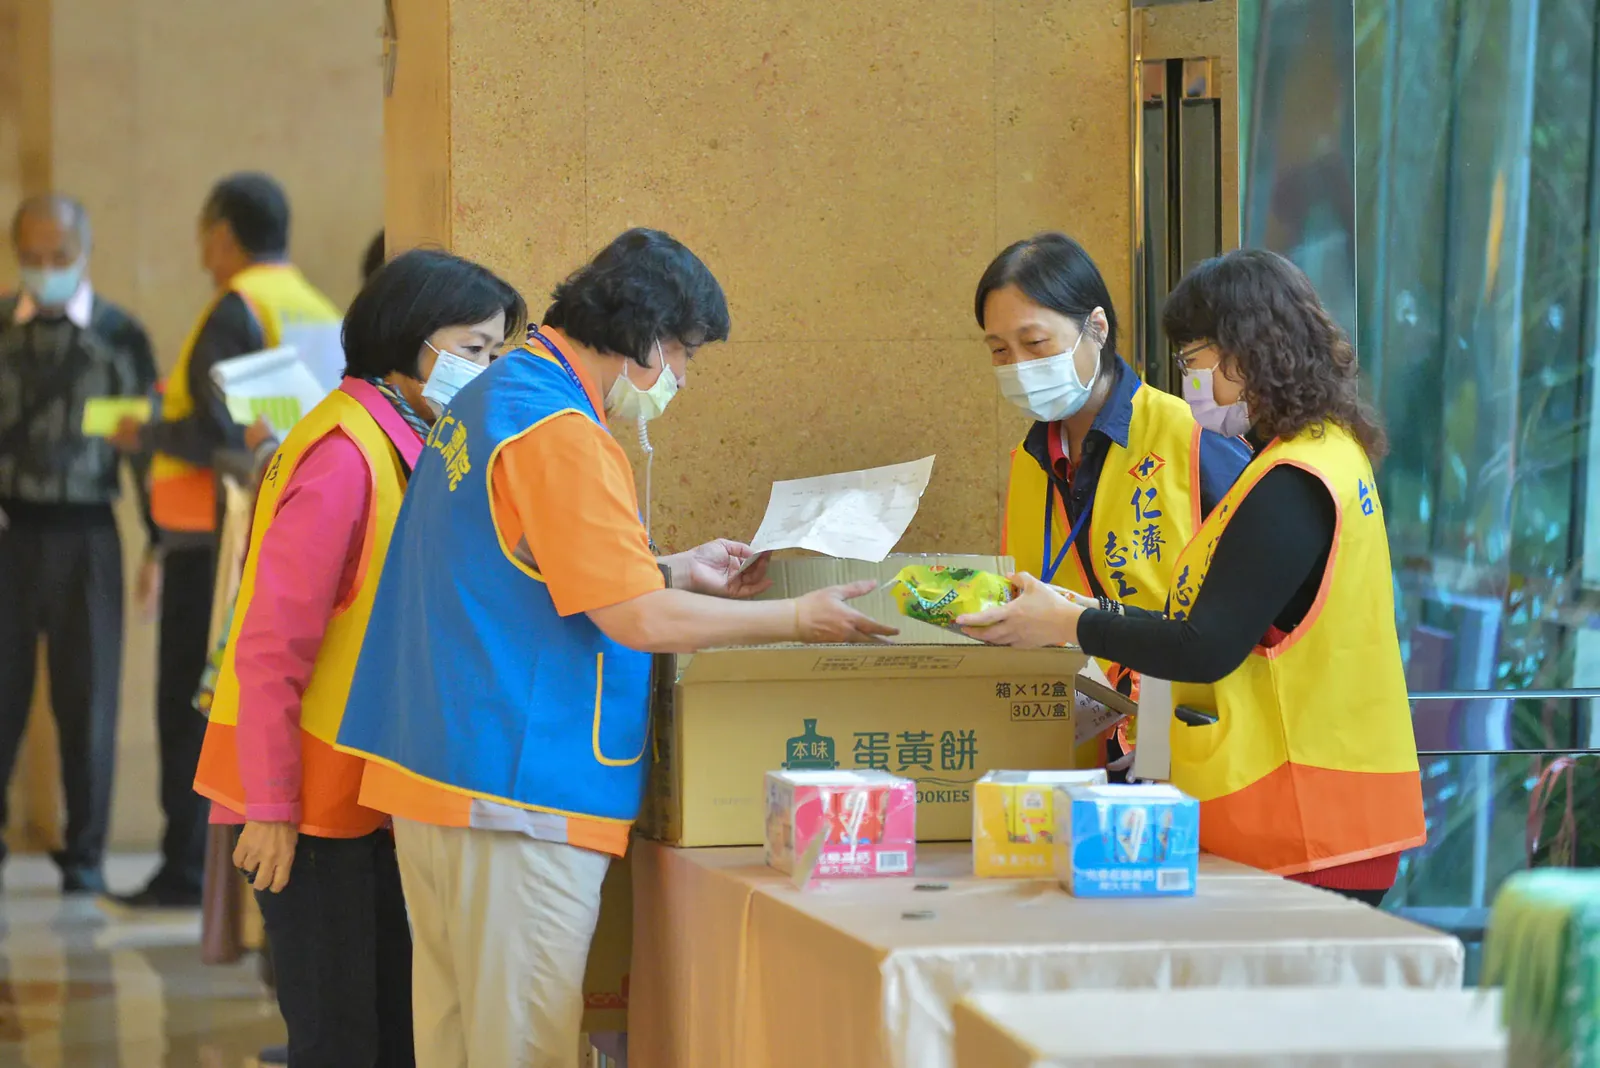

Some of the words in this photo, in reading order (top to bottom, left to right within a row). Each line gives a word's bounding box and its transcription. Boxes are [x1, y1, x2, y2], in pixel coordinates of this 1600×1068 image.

[1130, 486, 1166, 563] 仁濟
[1104, 531, 1138, 598] 志工
[1012, 703, 1067, 718] 30入/盒
[792, 741, 829, 760] 本味
[852, 729, 979, 773] 蛋黃餅
[915, 789, 970, 804] OOKIES
